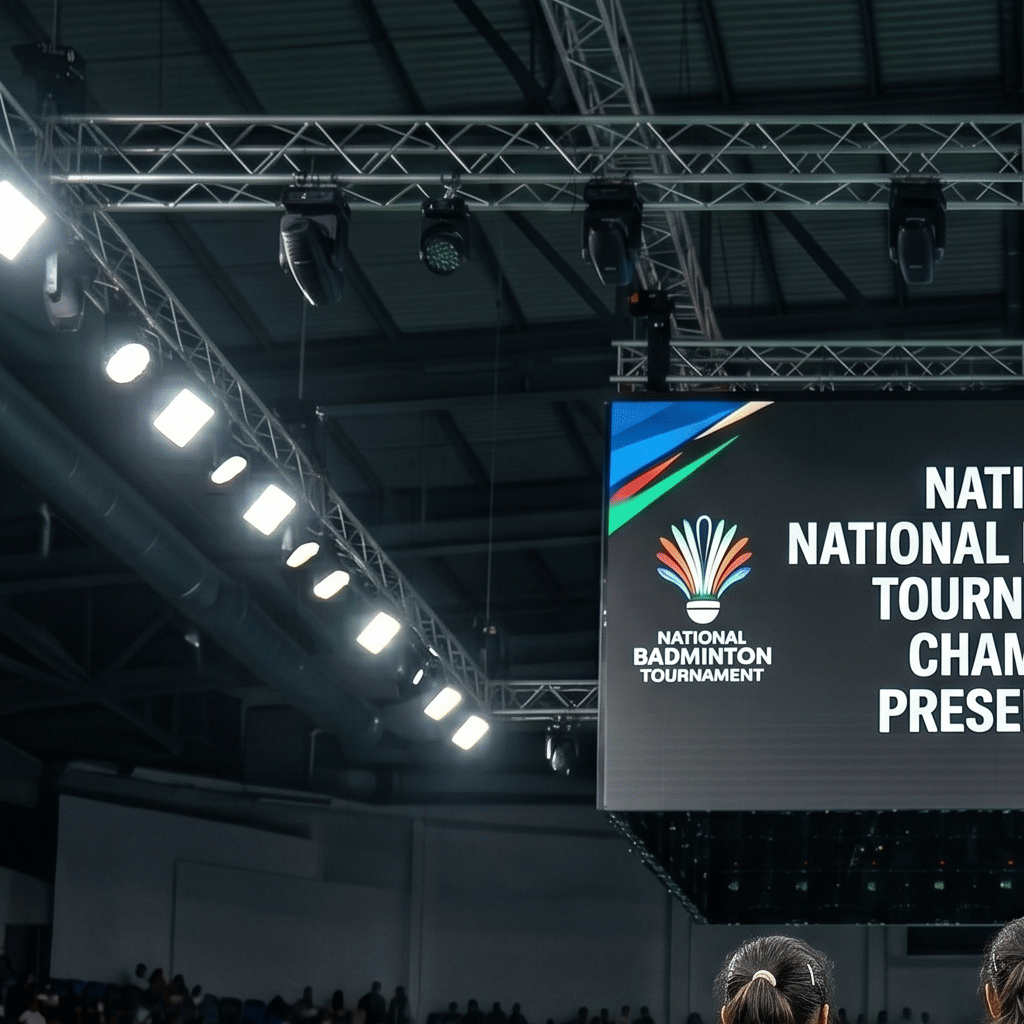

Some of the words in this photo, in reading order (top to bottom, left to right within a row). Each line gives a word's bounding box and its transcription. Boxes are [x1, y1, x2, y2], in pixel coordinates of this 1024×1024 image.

[788, 521, 1010, 566] NATIONAL
[657, 630, 747, 645] NATIONAL
[633, 646, 772, 666] BADMINTON
[639, 667, 765, 683] TOURNAMENT
